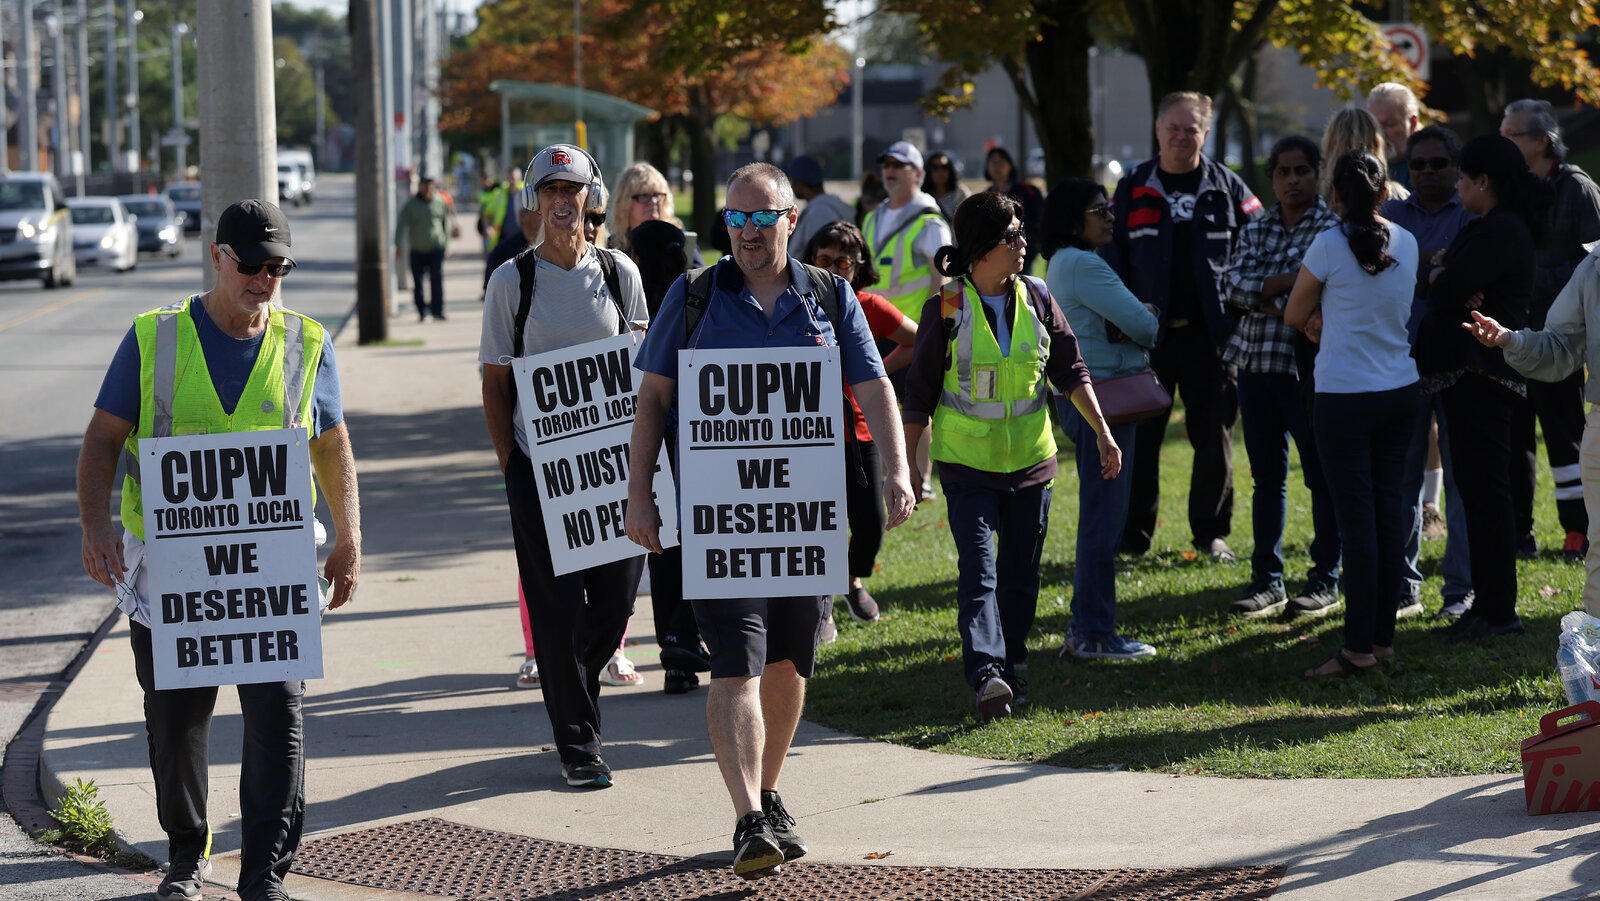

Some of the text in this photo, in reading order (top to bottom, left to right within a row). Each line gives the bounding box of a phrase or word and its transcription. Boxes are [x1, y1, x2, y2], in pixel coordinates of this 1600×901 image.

[532, 348, 633, 413] CUPW
[698, 361, 822, 416] CUPW
[532, 395, 638, 438] TORONTO LOCA
[689, 416, 835, 442] TORONTO LOCAL
[160, 444, 288, 504] CUPW
[541, 457, 575, 499] NO
[736, 457, 791, 490] WE
[153, 499, 304, 531] TORONTO LOCAL
[562, 508, 595, 550] NO
[692, 500, 838, 535] DESERVE
[203, 542, 259, 577] WE
[705, 545, 827, 580] BETTER
[160, 583, 309, 625] DESERVE
[175, 629, 300, 669] BETTER
